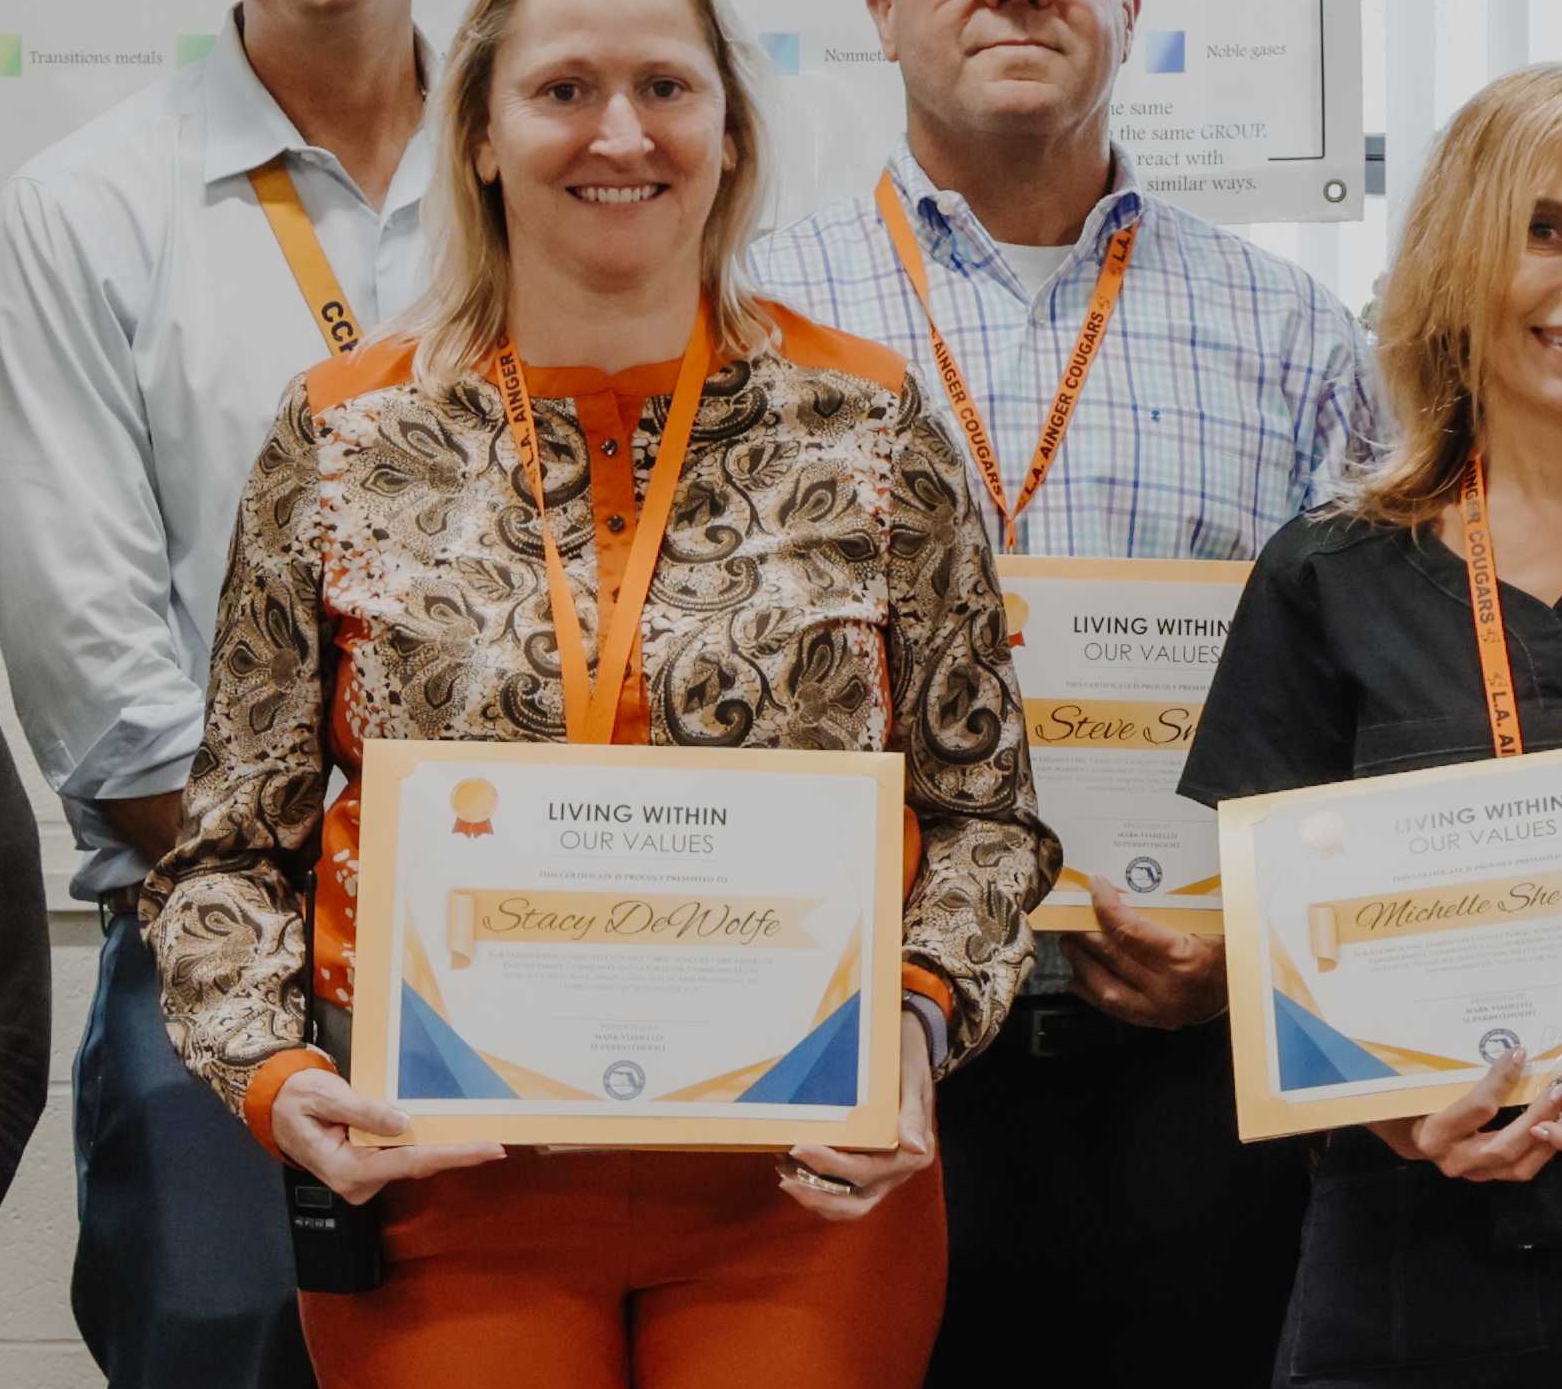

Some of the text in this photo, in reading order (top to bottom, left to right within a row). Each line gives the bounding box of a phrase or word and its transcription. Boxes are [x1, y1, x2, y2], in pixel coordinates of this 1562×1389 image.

[30, 51, 162, 65] Transitions metals
[1207, 44, 1247, 59] Noble
[1120, 125, 1146, 141] the
[1152, 127, 1195, 140] same
[1137, 151, 1223, 166] react with
[1147, 176, 1257, 192] similar ways.
[500, 352, 526, 424] AINGER
[1039, 391, 1075, 461] AINGER
[1064, 310, 1104, 393] COUGARS
[933, 341, 1003, 496] AINGER COUGARS
[1468, 530, 1494, 624] COUGARS
[1074, 616, 1231, 637] LIVING WITHIN
[1084, 642, 1221, 663] OUR VALUES
[1491, 690, 1509, 727] L.A.
[1035, 705, 1137, 743] Steve
[549, 803, 727, 825] LIVING WITHIN
[1395, 807, 1475, 834] LIVING
[560, 830, 714, 853] OUR VALUES
[1409, 819, 1557, 855] OUR VALUES
[483, 897, 782, 944] Stacy DeWolfe
[1355, 893, 1493, 931] Michelle
